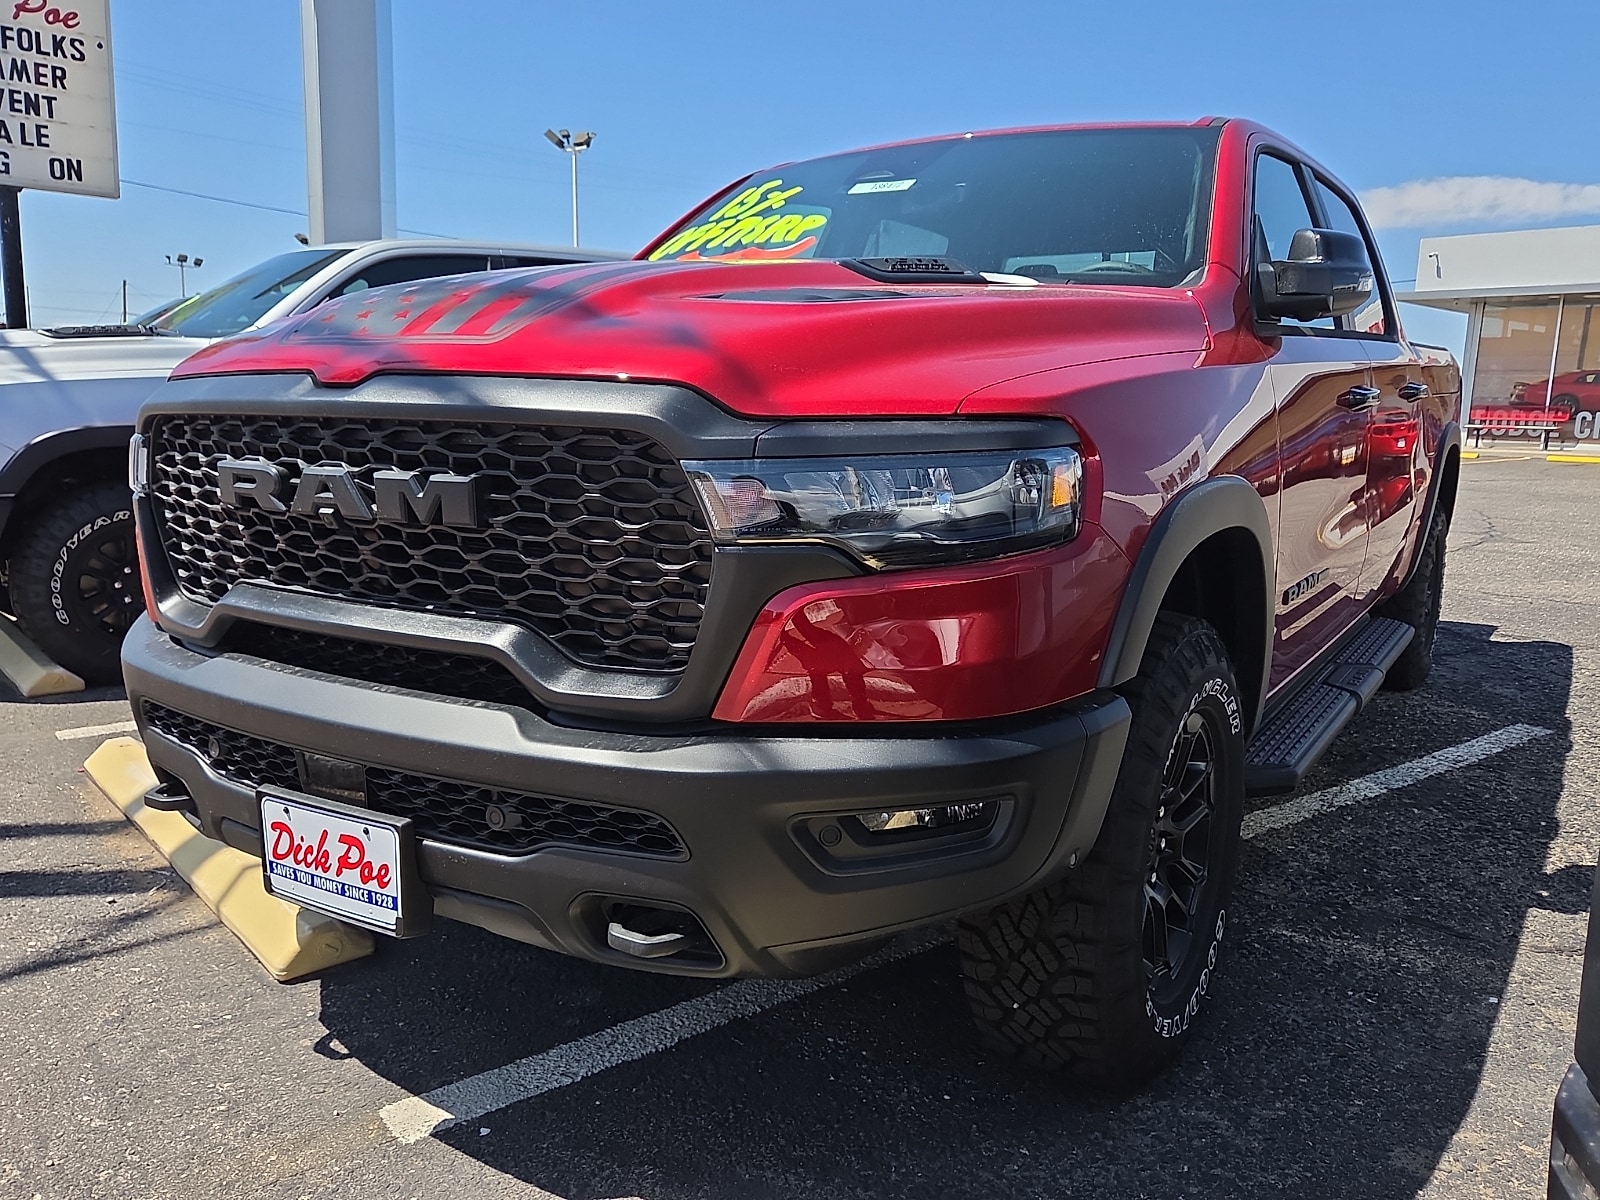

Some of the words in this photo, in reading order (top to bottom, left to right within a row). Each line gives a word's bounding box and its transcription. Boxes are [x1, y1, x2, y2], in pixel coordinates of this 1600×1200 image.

[12, 0, 81, 29] Poe
[0, 25, 86, 62] FOLKS
[49, 157, 83, 182] ON
[217, 459, 477, 528] RAM
[51, 510, 131, 625] GOODYEAR
[1282, 572, 1319, 605] RAM
[270, 821, 333, 874] Dick
[335, 833, 393, 890] Poe
[272, 864, 295, 881] SAVES
[295, 870, 312, 886] YOU
[313, 876, 343, 895] MONEY
[344, 885, 369, 903] SINCE
[371, 892, 394, 909] 1928
